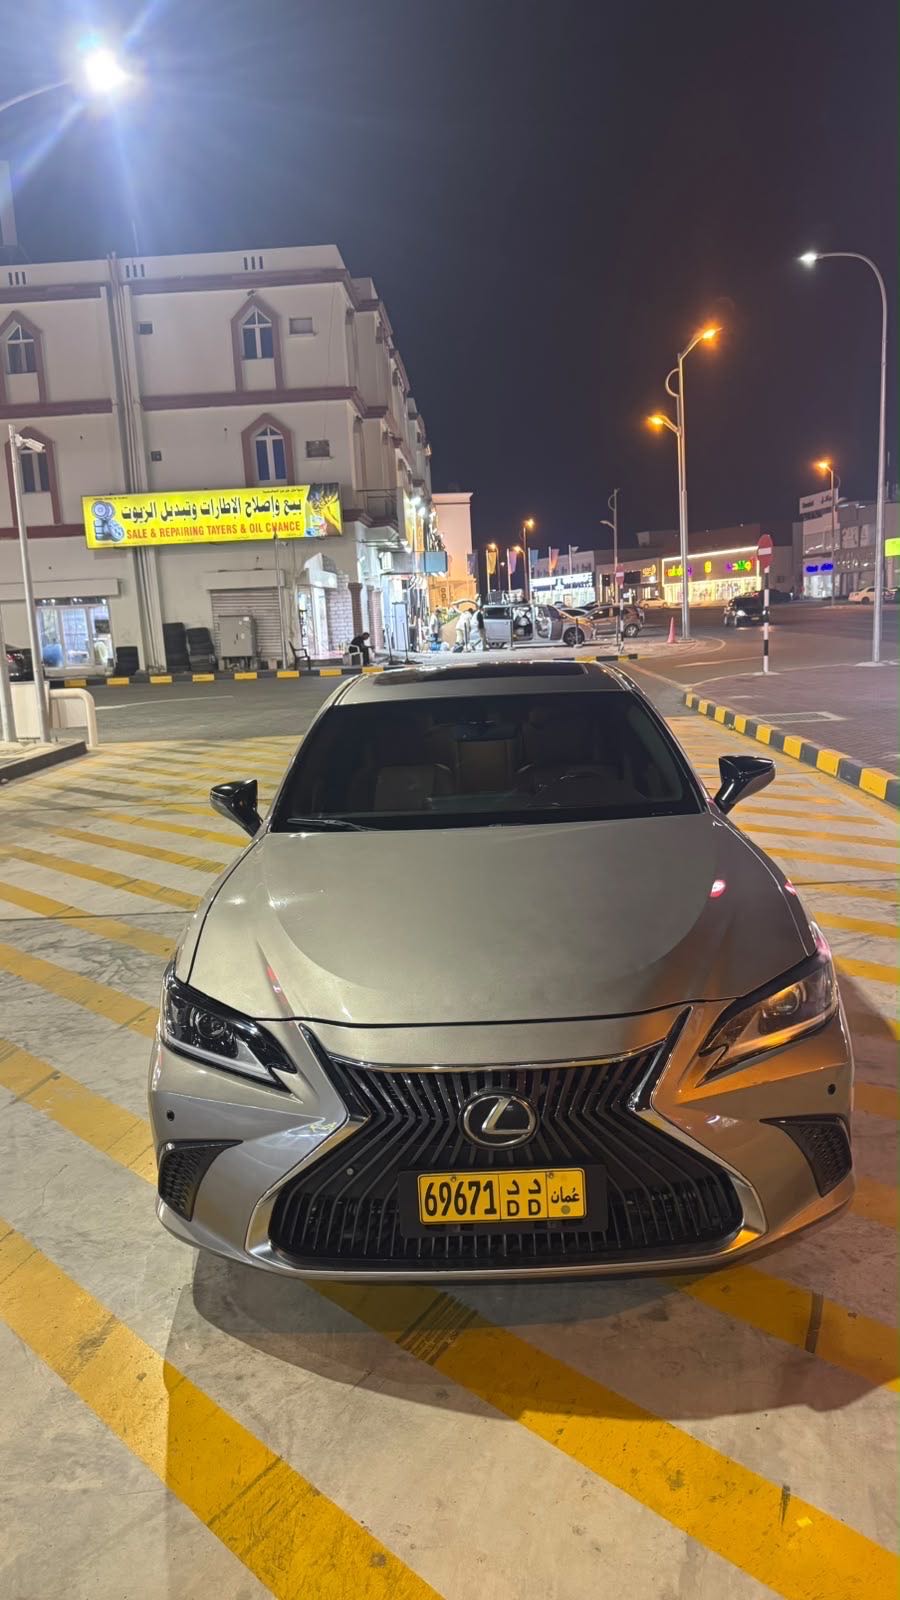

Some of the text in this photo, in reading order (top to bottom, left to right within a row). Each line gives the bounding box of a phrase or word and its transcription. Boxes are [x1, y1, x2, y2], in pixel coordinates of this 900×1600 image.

[121, 501, 158, 524] الزيوت
[160, 501, 198, 522] وتبديل
[283, 499, 302, 516] بيع
[127, 528, 148, 540] SALE
[150, 528, 158, 538] &
[159, 526, 205, 538] REPAIRING
[206, 524, 238, 536] TAYERS
[240, 524, 246, 534] &
[249, 522, 263, 533] OIL
[424, 1180, 497, 1217] 69671
